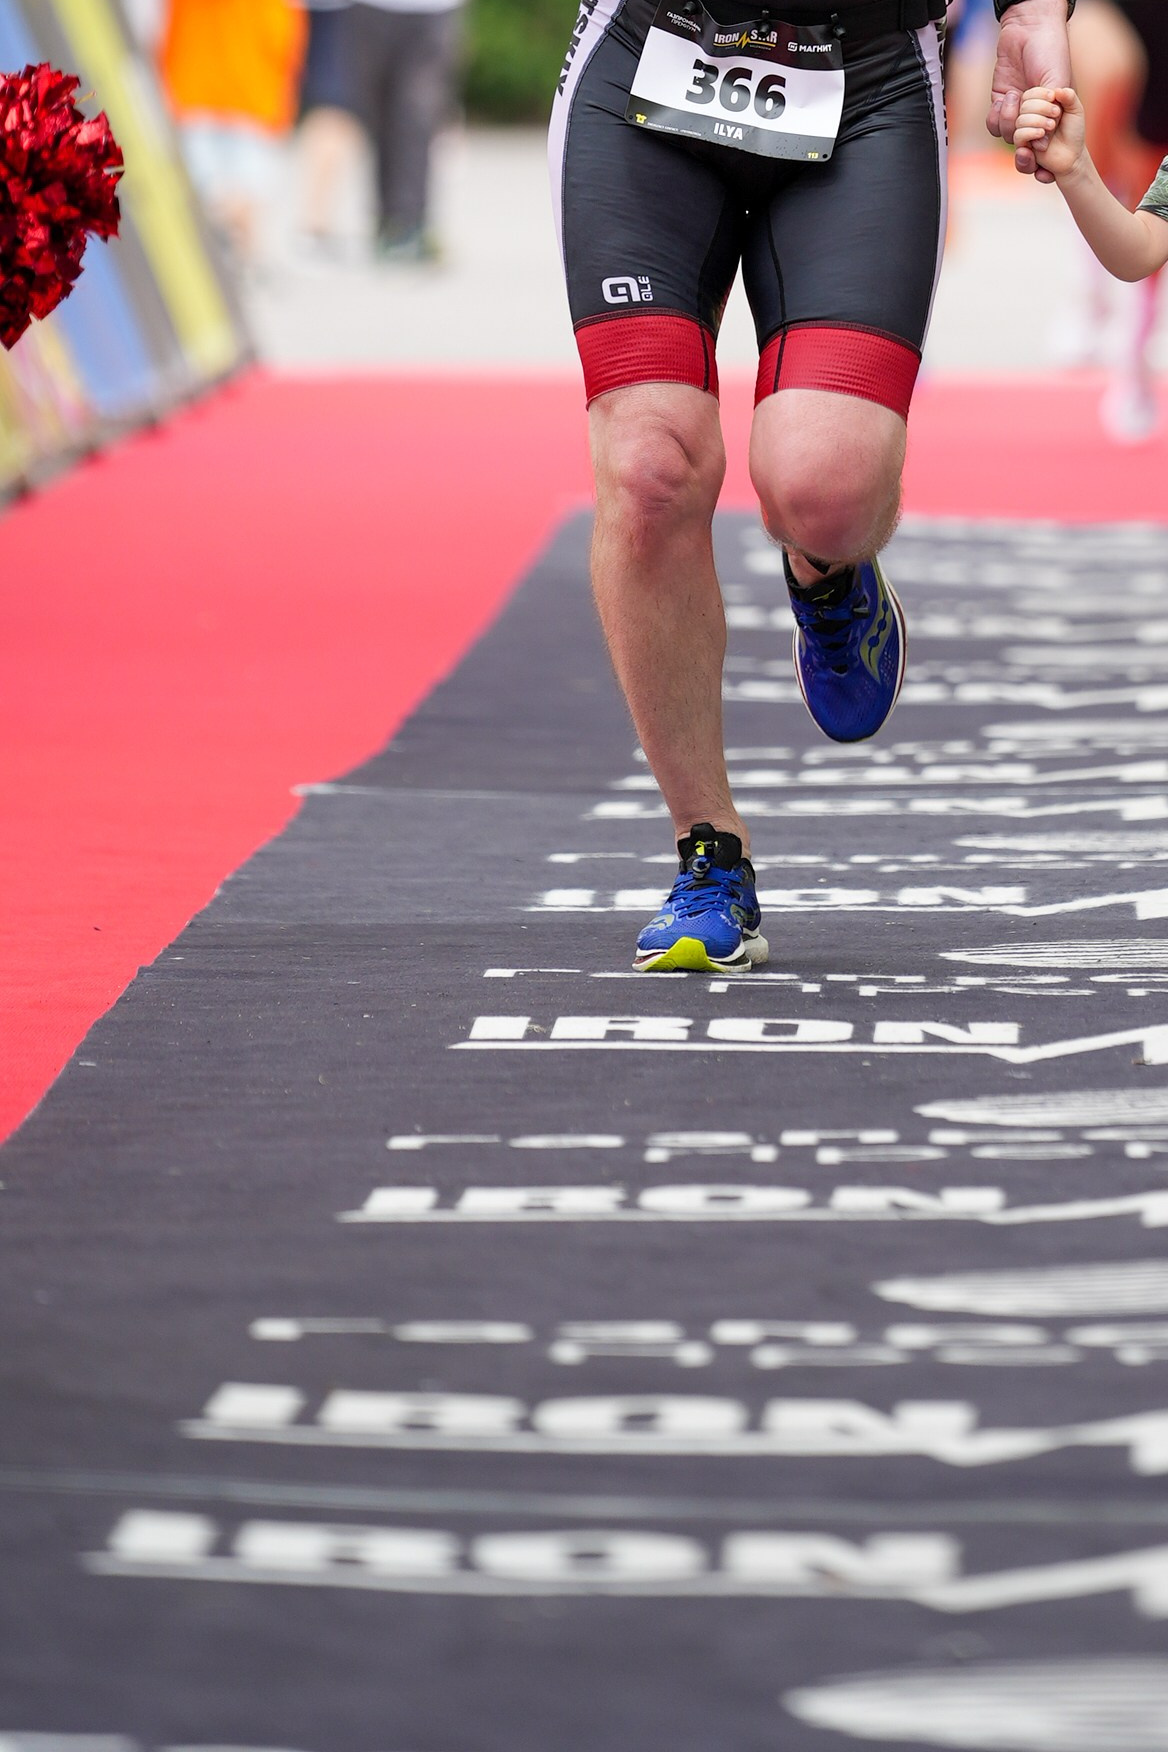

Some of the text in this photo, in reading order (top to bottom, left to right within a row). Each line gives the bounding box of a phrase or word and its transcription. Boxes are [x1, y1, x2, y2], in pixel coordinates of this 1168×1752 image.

[714, 32, 739, 44] IRON
[798, 43, 833, 53] МАГНИТ
[685, 59, 786, 120] 366
[713, 122, 743, 140] ILYA
